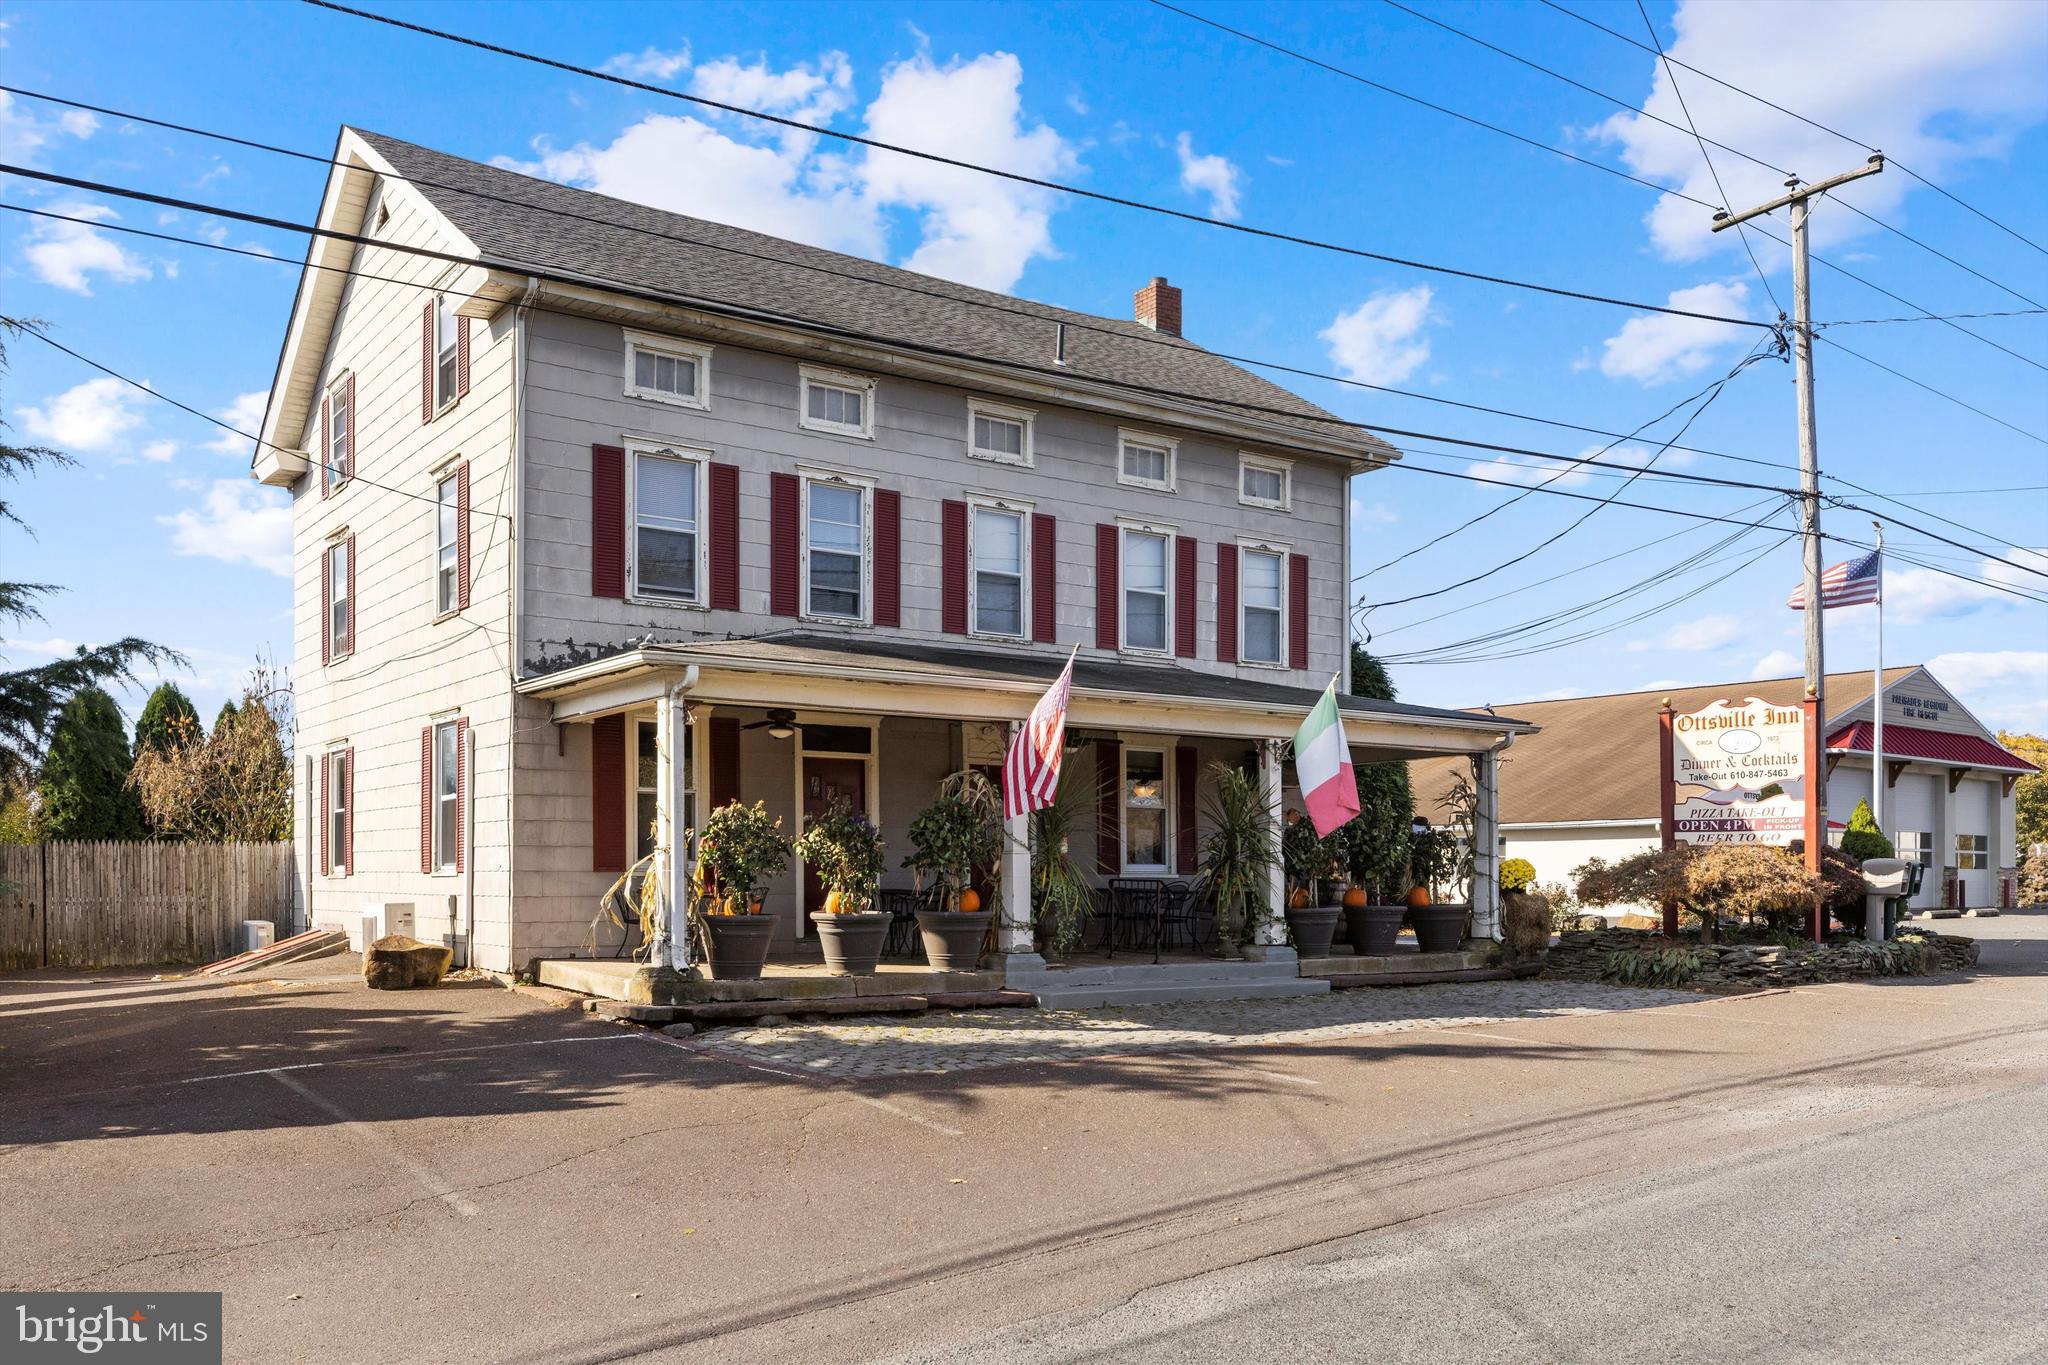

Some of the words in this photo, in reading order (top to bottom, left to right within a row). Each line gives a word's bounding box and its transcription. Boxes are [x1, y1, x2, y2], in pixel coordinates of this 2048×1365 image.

[1678, 710, 1756, 732] Ottsville
[1763, 707, 1800, 726] Inn
[1680, 757, 1722, 771] Dinner
[1726, 756, 1737, 768] &
[1741, 752, 1798, 767] Cocktails
[1689, 773, 1727, 782] Take-Out
[1730, 768, 1788, 780] 610-847-5463
[1690, 808, 1723, 818] PIZZA
[1727, 806, 1788, 818] TAKE-OUT
[1679, 820, 1720, 831] OPEN
[1723, 819, 1756, 831] 4PM
[1697, 833, 1733, 843] BEER
[1738, 832, 1757, 842] TO
[1760, 832, 1782, 842] GO
